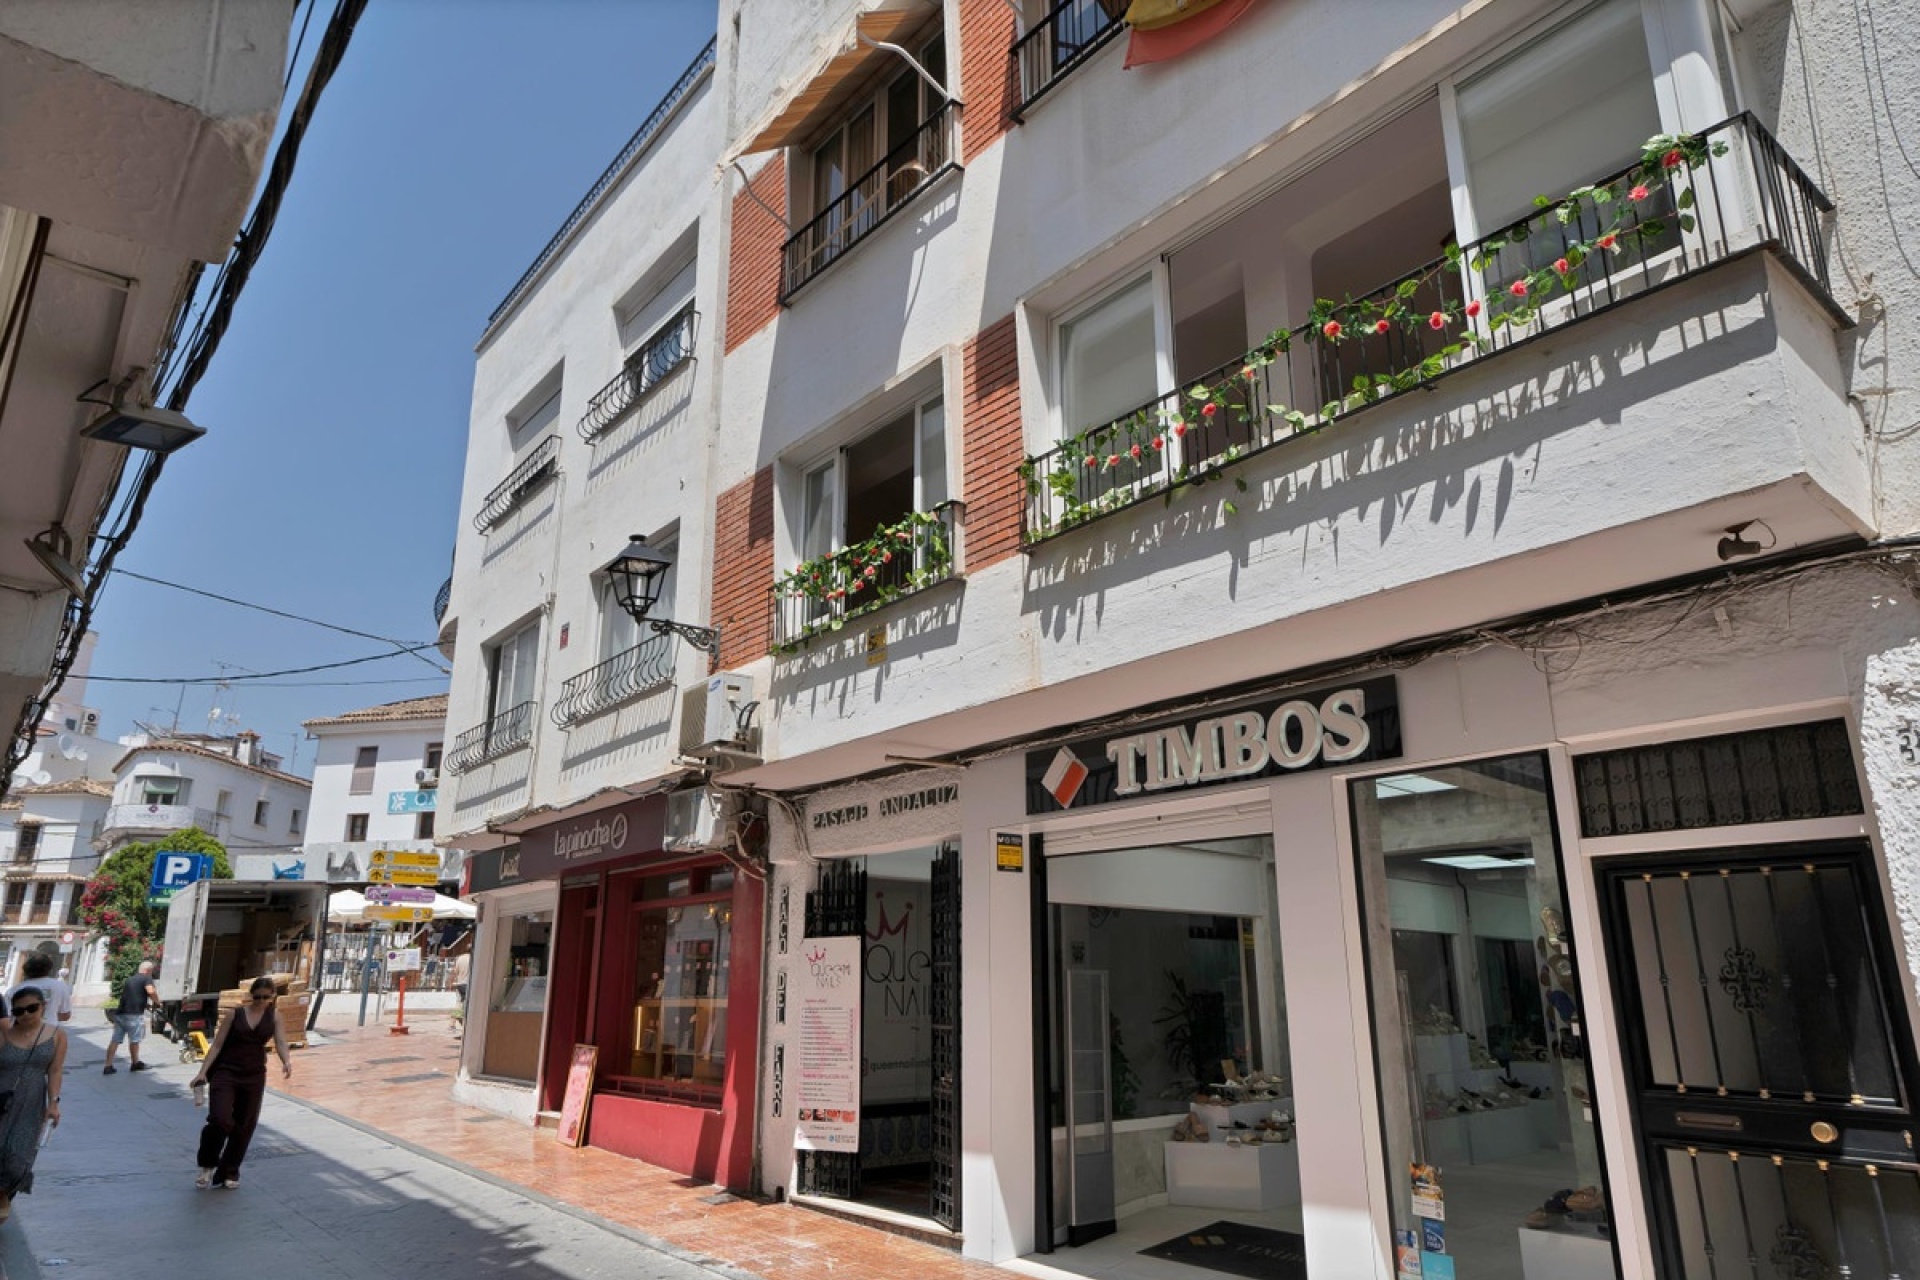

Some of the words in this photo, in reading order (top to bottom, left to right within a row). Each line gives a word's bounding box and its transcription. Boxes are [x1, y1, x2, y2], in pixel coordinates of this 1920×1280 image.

[1106, 687, 1370, 796] TIMBOS
[813, 801, 868, 829] PASAJE
[879, 782, 959, 818] ANDALUZ
[163, 855, 191, 885] P
